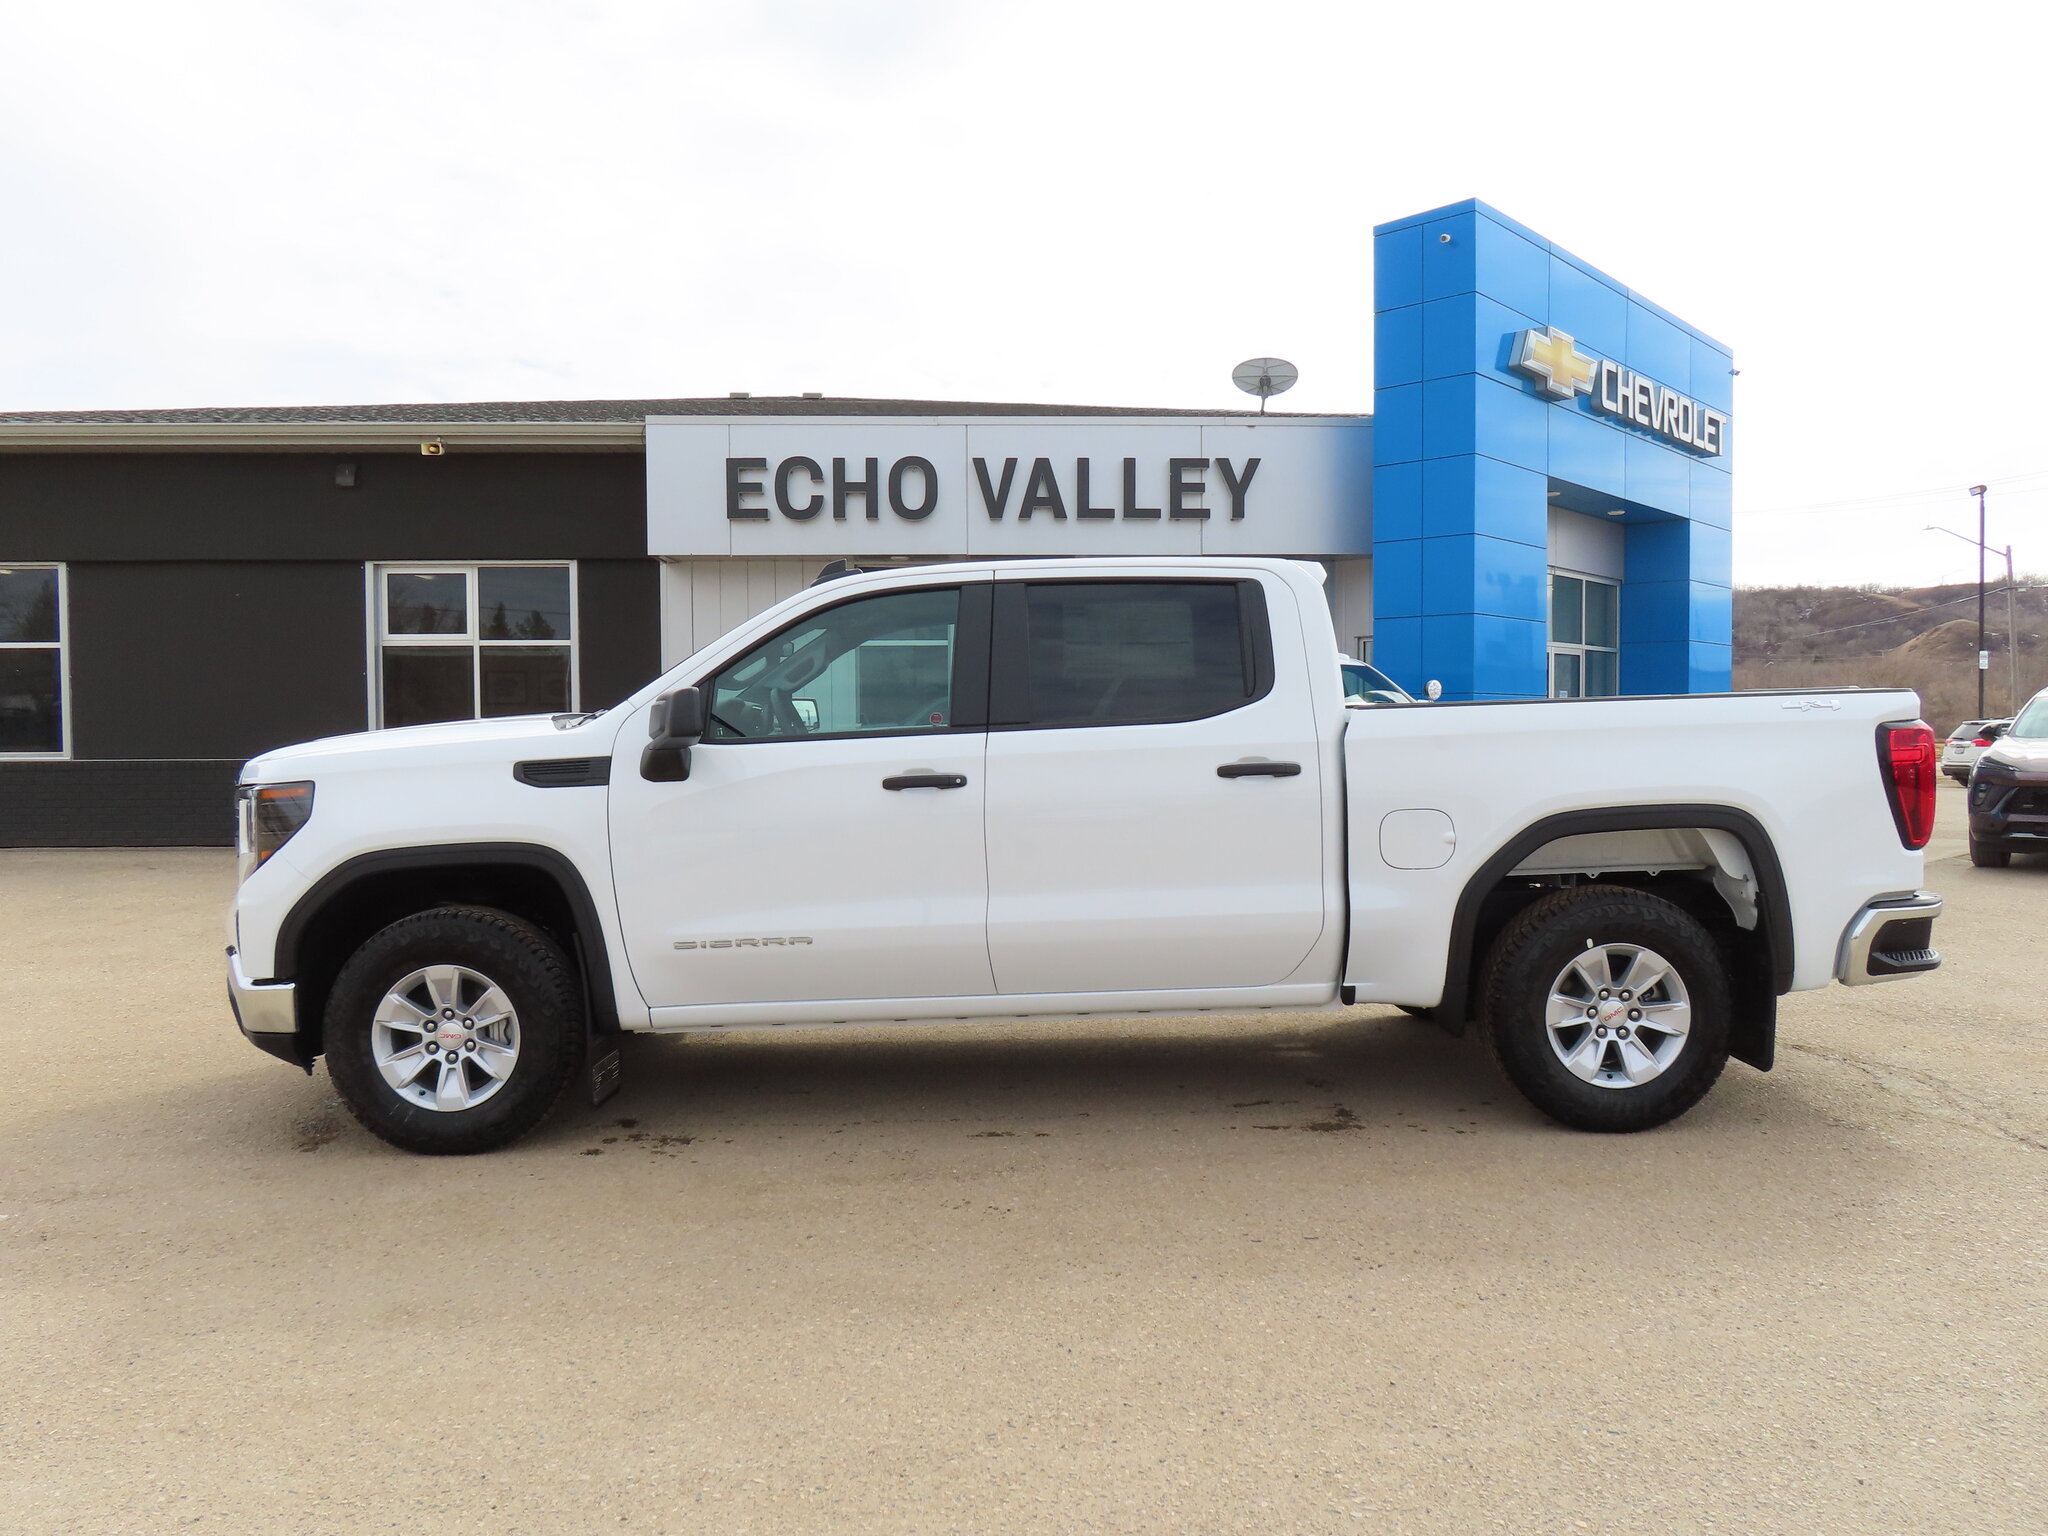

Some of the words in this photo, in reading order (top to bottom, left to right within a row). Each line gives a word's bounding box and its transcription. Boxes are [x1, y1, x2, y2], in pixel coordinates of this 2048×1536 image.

[1599, 359, 1727, 457] CHEVROLET
[725, 456, 938, 521] ECHO
[972, 457, 1262, 521] VALLEY
[673, 936, 813, 950] SIERRA
[1603, 1006, 1624, 1022] GMC
